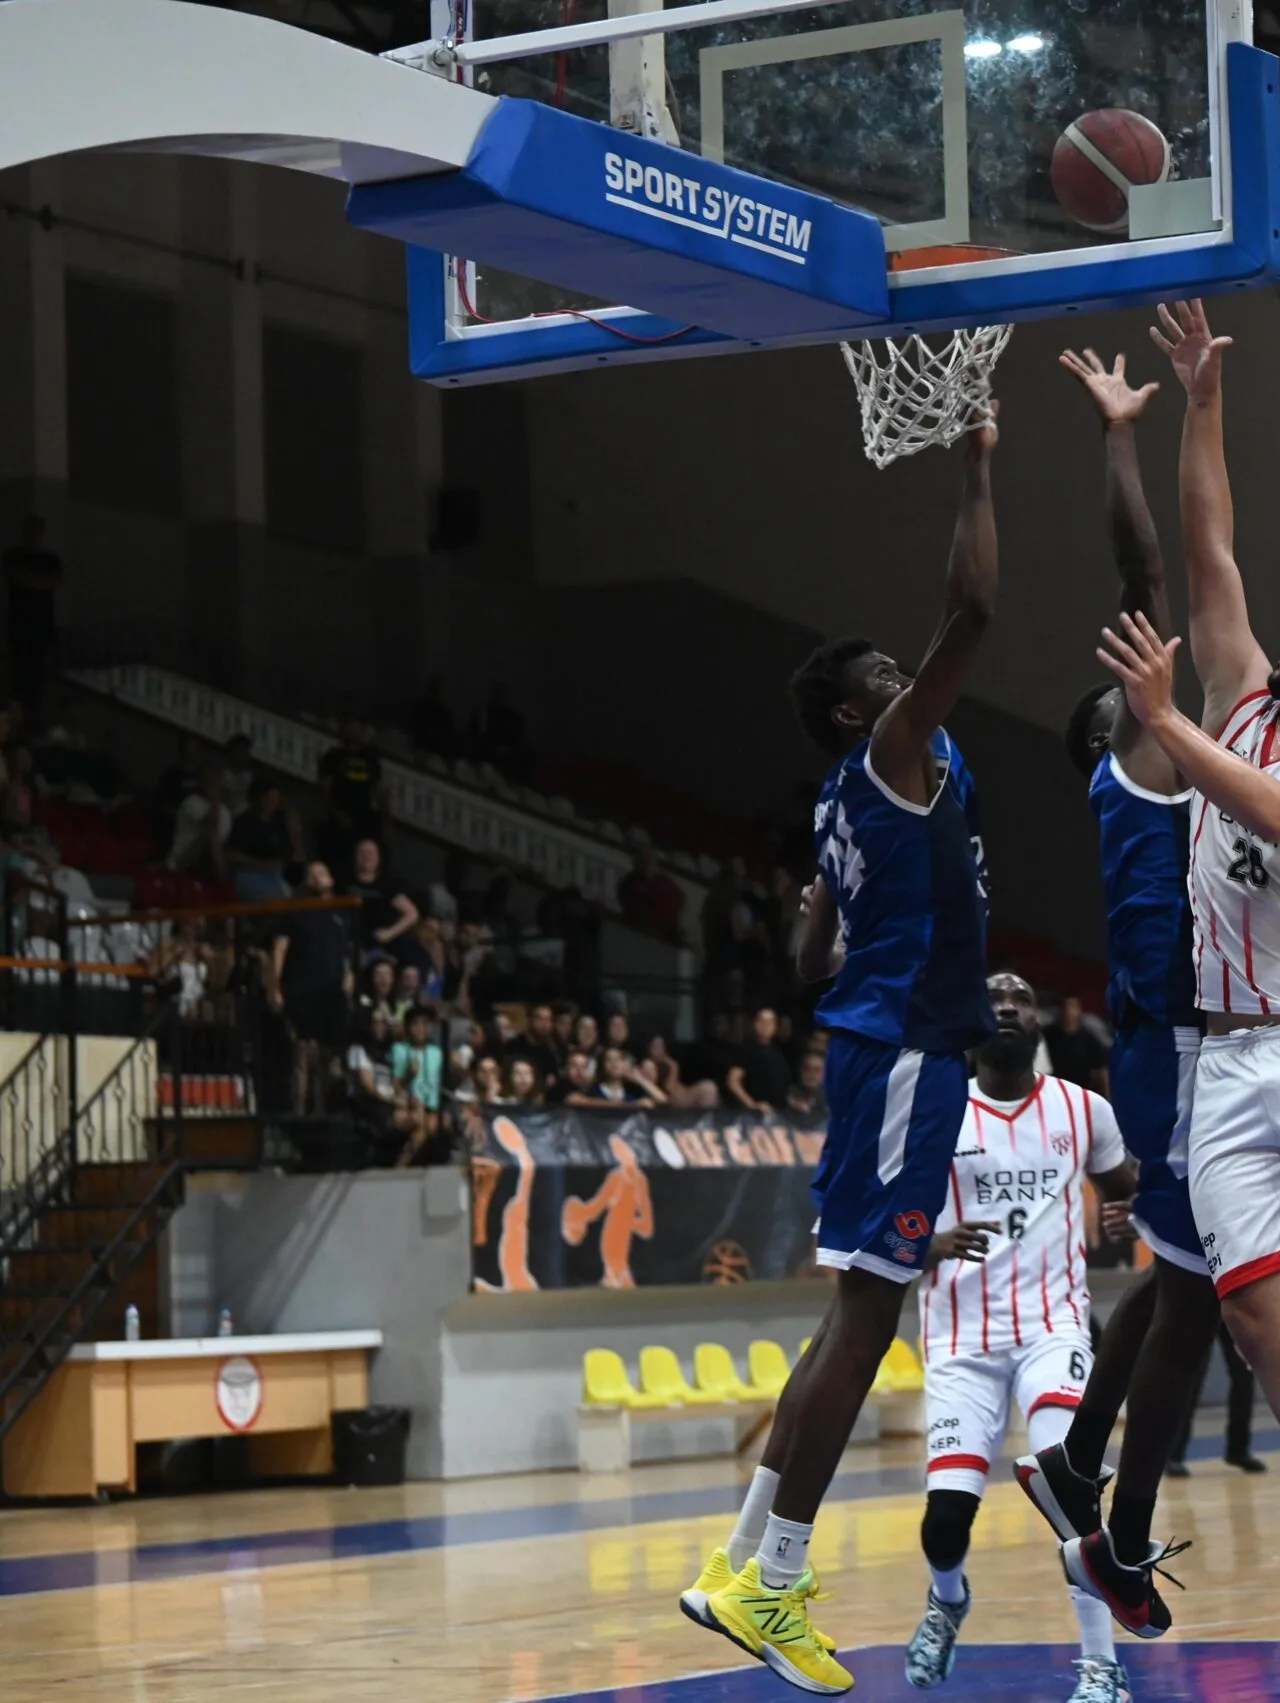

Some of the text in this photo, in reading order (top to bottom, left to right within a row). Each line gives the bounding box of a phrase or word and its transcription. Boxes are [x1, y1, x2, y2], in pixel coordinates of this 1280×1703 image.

[605, 152, 812, 252] SPORT SYSTEM
[974, 1168, 1059, 1188] KOOP
[977, 1187, 1058, 1205] BANK
[1008, 1206, 1029, 1240] 6
[1069, 1350, 1085, 1381] 6
